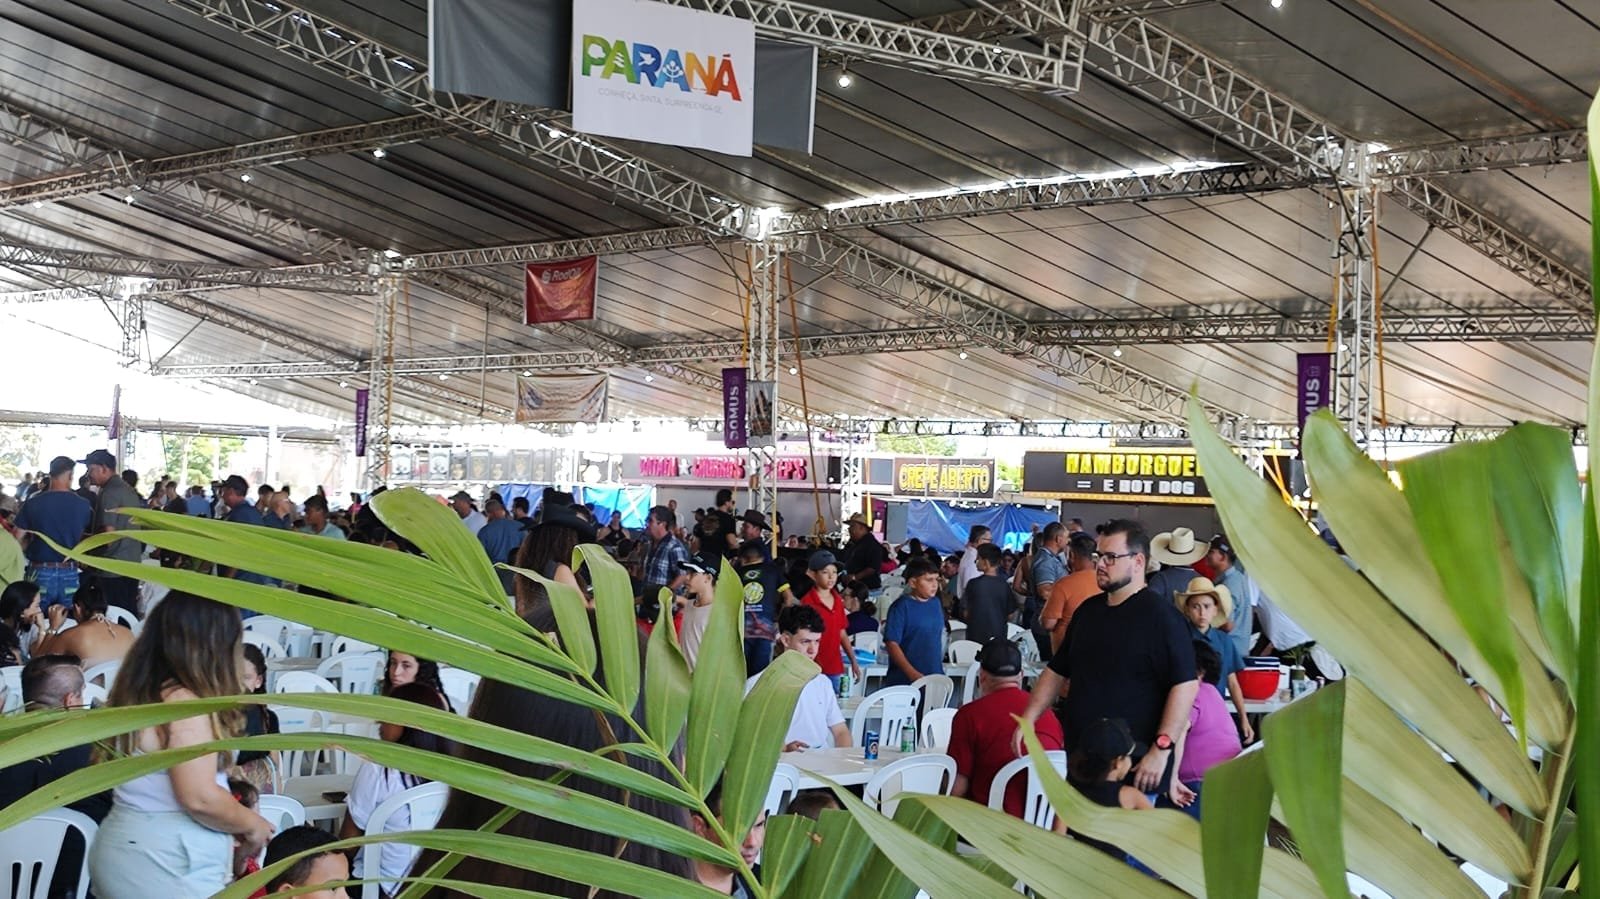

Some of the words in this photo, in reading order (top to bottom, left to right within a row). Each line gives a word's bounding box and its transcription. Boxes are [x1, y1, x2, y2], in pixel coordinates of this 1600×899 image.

[582, 34, 742, 102] PARANÁ
[729, 386, 739, 441] DOMUS
[939, 464, 990, 493] ABERTO
[1119, 480, 1153, 493] HOT
[1159, 480, 1195, 495] DOG
